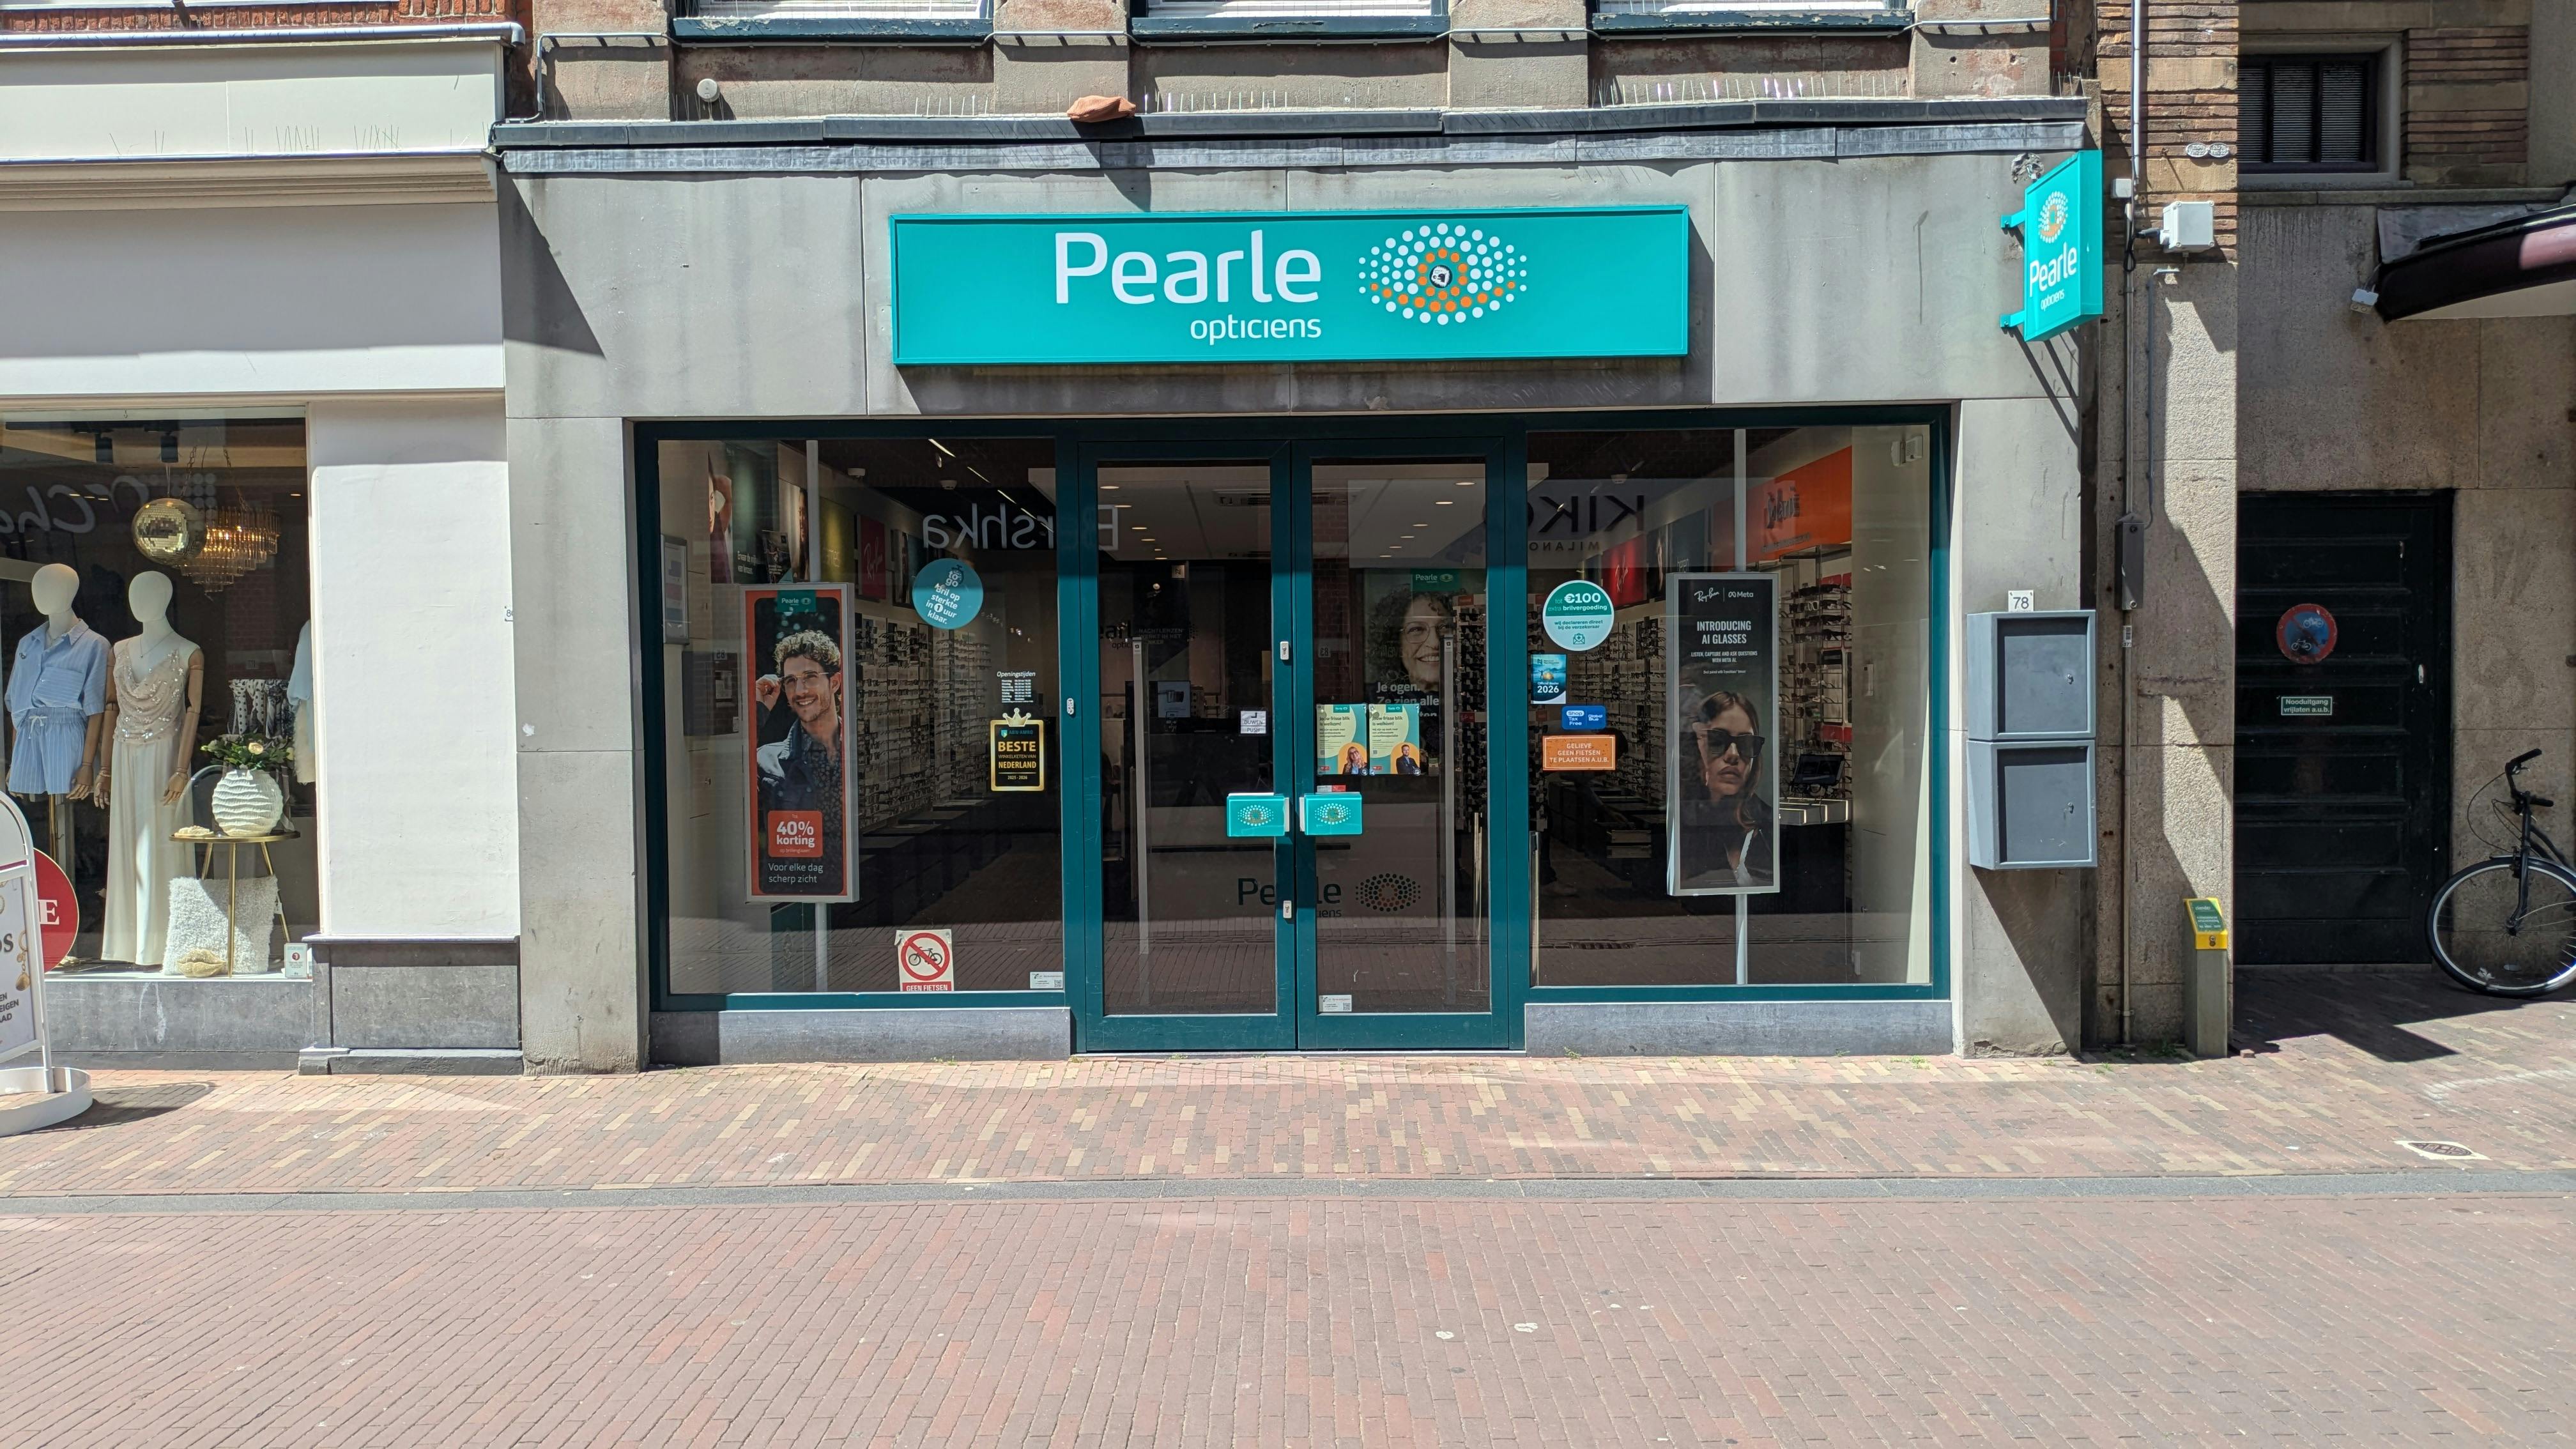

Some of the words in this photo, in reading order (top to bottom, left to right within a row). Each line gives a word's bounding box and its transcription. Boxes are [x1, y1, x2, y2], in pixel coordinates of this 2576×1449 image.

[1055, 229, 1321, 305] Pearle
[2029, 241, 2077, 298] Pearle
[2040, 288, 2065, 312] opticiens
[1190, 314, 1322, 346] opticiens
[946, 578, 958, 587] go
[948, 571, 958, 580] to
[935, 586, 949, 596] Bril
[950, 594, 960, 602] op
[1564, 592, 1601, 604] €100
[1694, 587, 1719, 602] Ray-Ban
[926, 600, 933, 609] in
[943, 609, 957, 618] uur
[931, 594, 958, 610] sterkte
[2013, 596, 2029, 610] 78
[927, 610, 947, 624] klaar.
[1697, 620, 1751, 631] INTRODUCING
[1702, 634, 1710, 644] AI
[1712, 634, 1747, 644] GLASSES
[1376, 682, 1388, 693] Je
[1390, 684, 1421, 694] ogen.
[998, 741, 1036, 751] BESTE
[776, 821, 814, 836] 40%
[776, 834, 815, 848] korting
[768, 863, 787, 871] Voor
[789, 863, 806, 871] elke
[808, 863, 823, 873] dag
[769, 874, 795, 884] scherp
[797, 875, 817, 883] zicht
